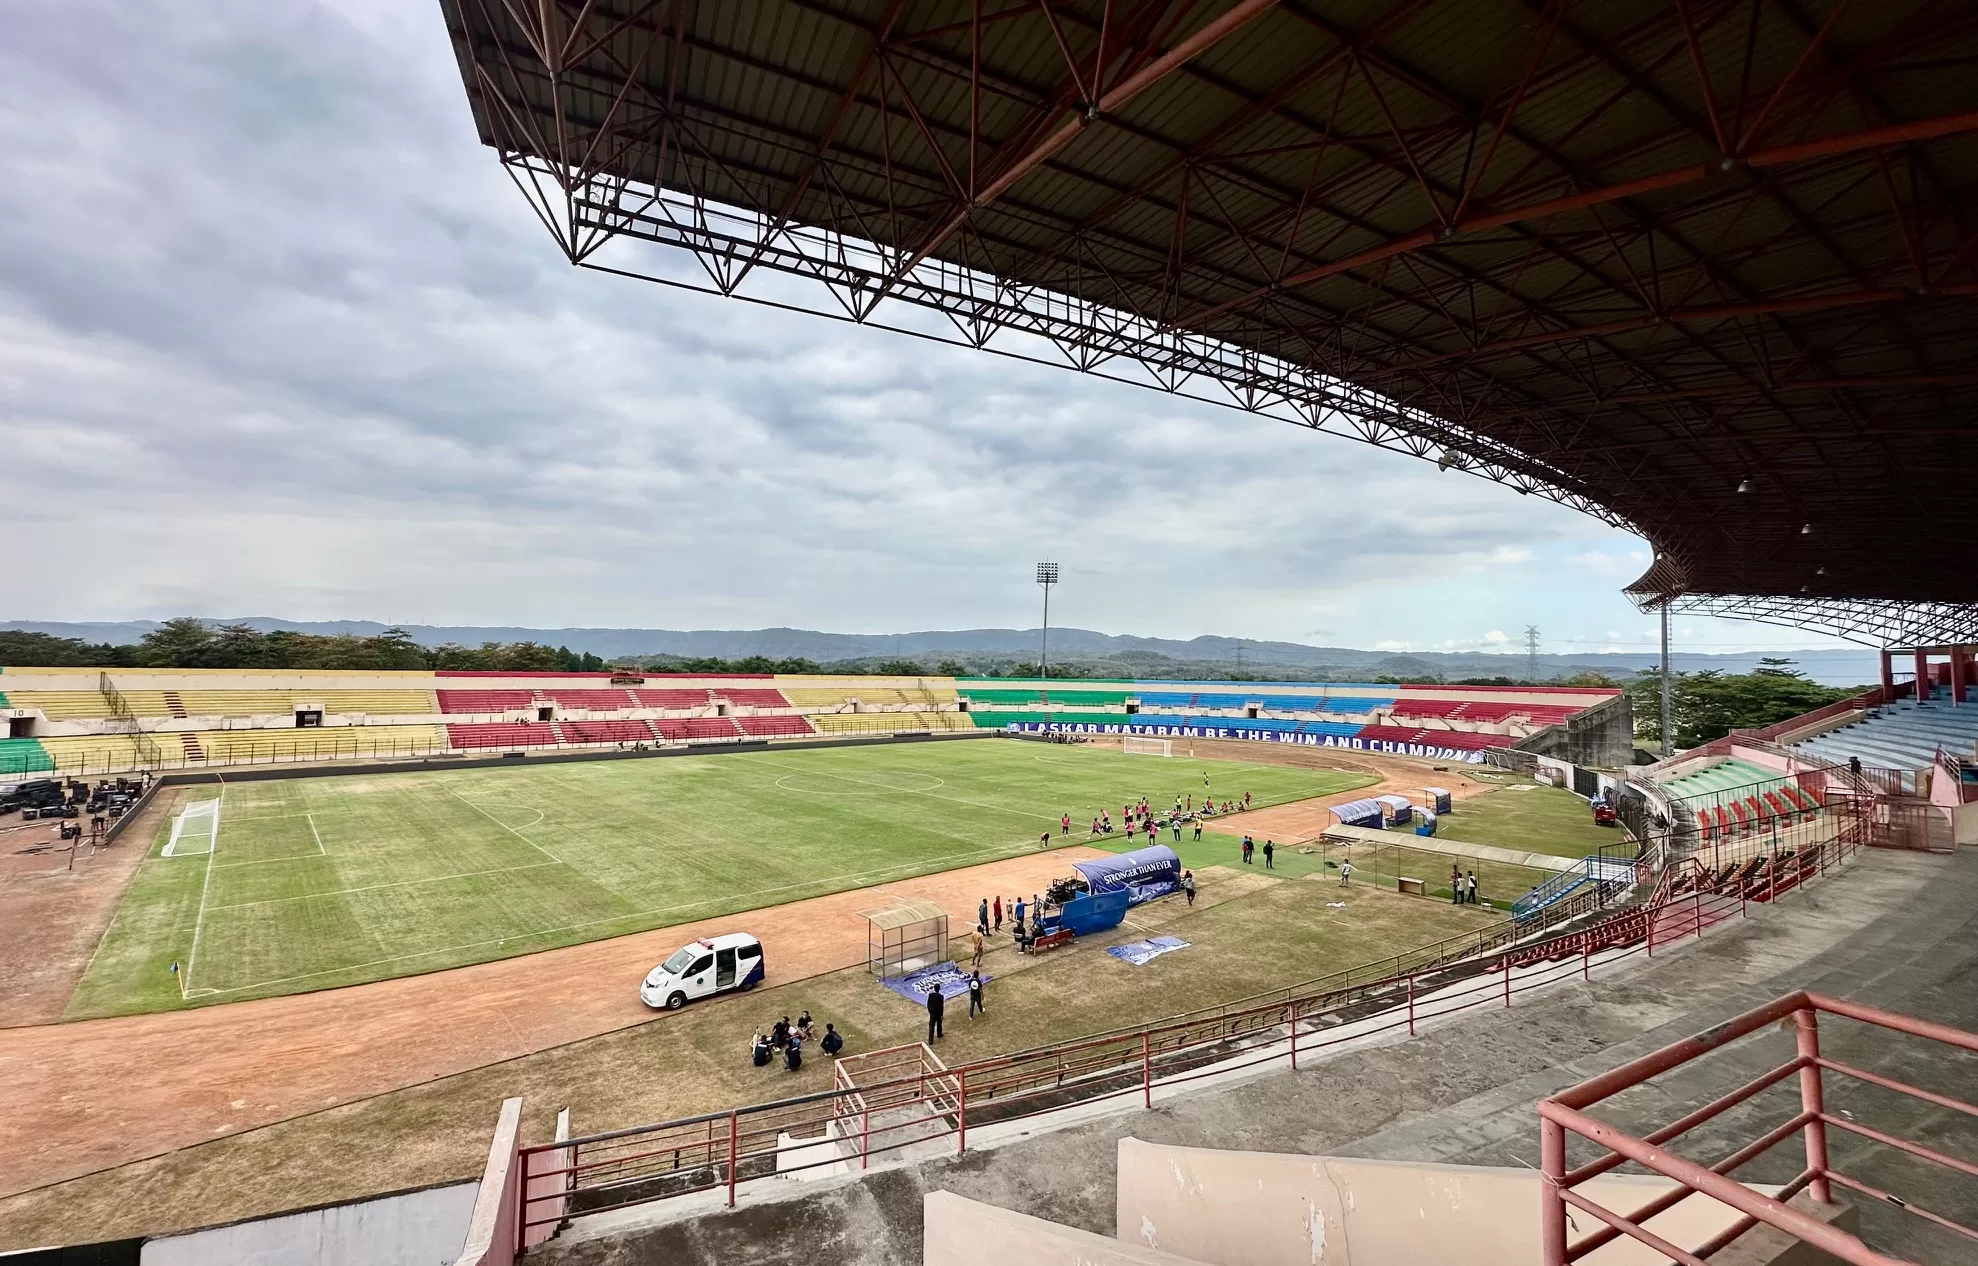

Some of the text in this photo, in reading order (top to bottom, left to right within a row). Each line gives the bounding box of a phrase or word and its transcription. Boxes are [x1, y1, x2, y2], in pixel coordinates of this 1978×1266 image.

[14, 709, 24, 717] 10
[1024, 722, 1098, 734] LASKAR
[1104, 723, 1198, 738] MATARAM
[1236, 729, 1273, 742] THE
[1279, 731, 1318, 745] WIN
[1323, 736, 1363, 749] AND
[1370, 739, 1467, 761] CHAMPION
[1103, 867, 1139, 885] STRONGER
[1137, 863, 1157, 875] THAN
[1155, 860, 1172, 870] EVER
